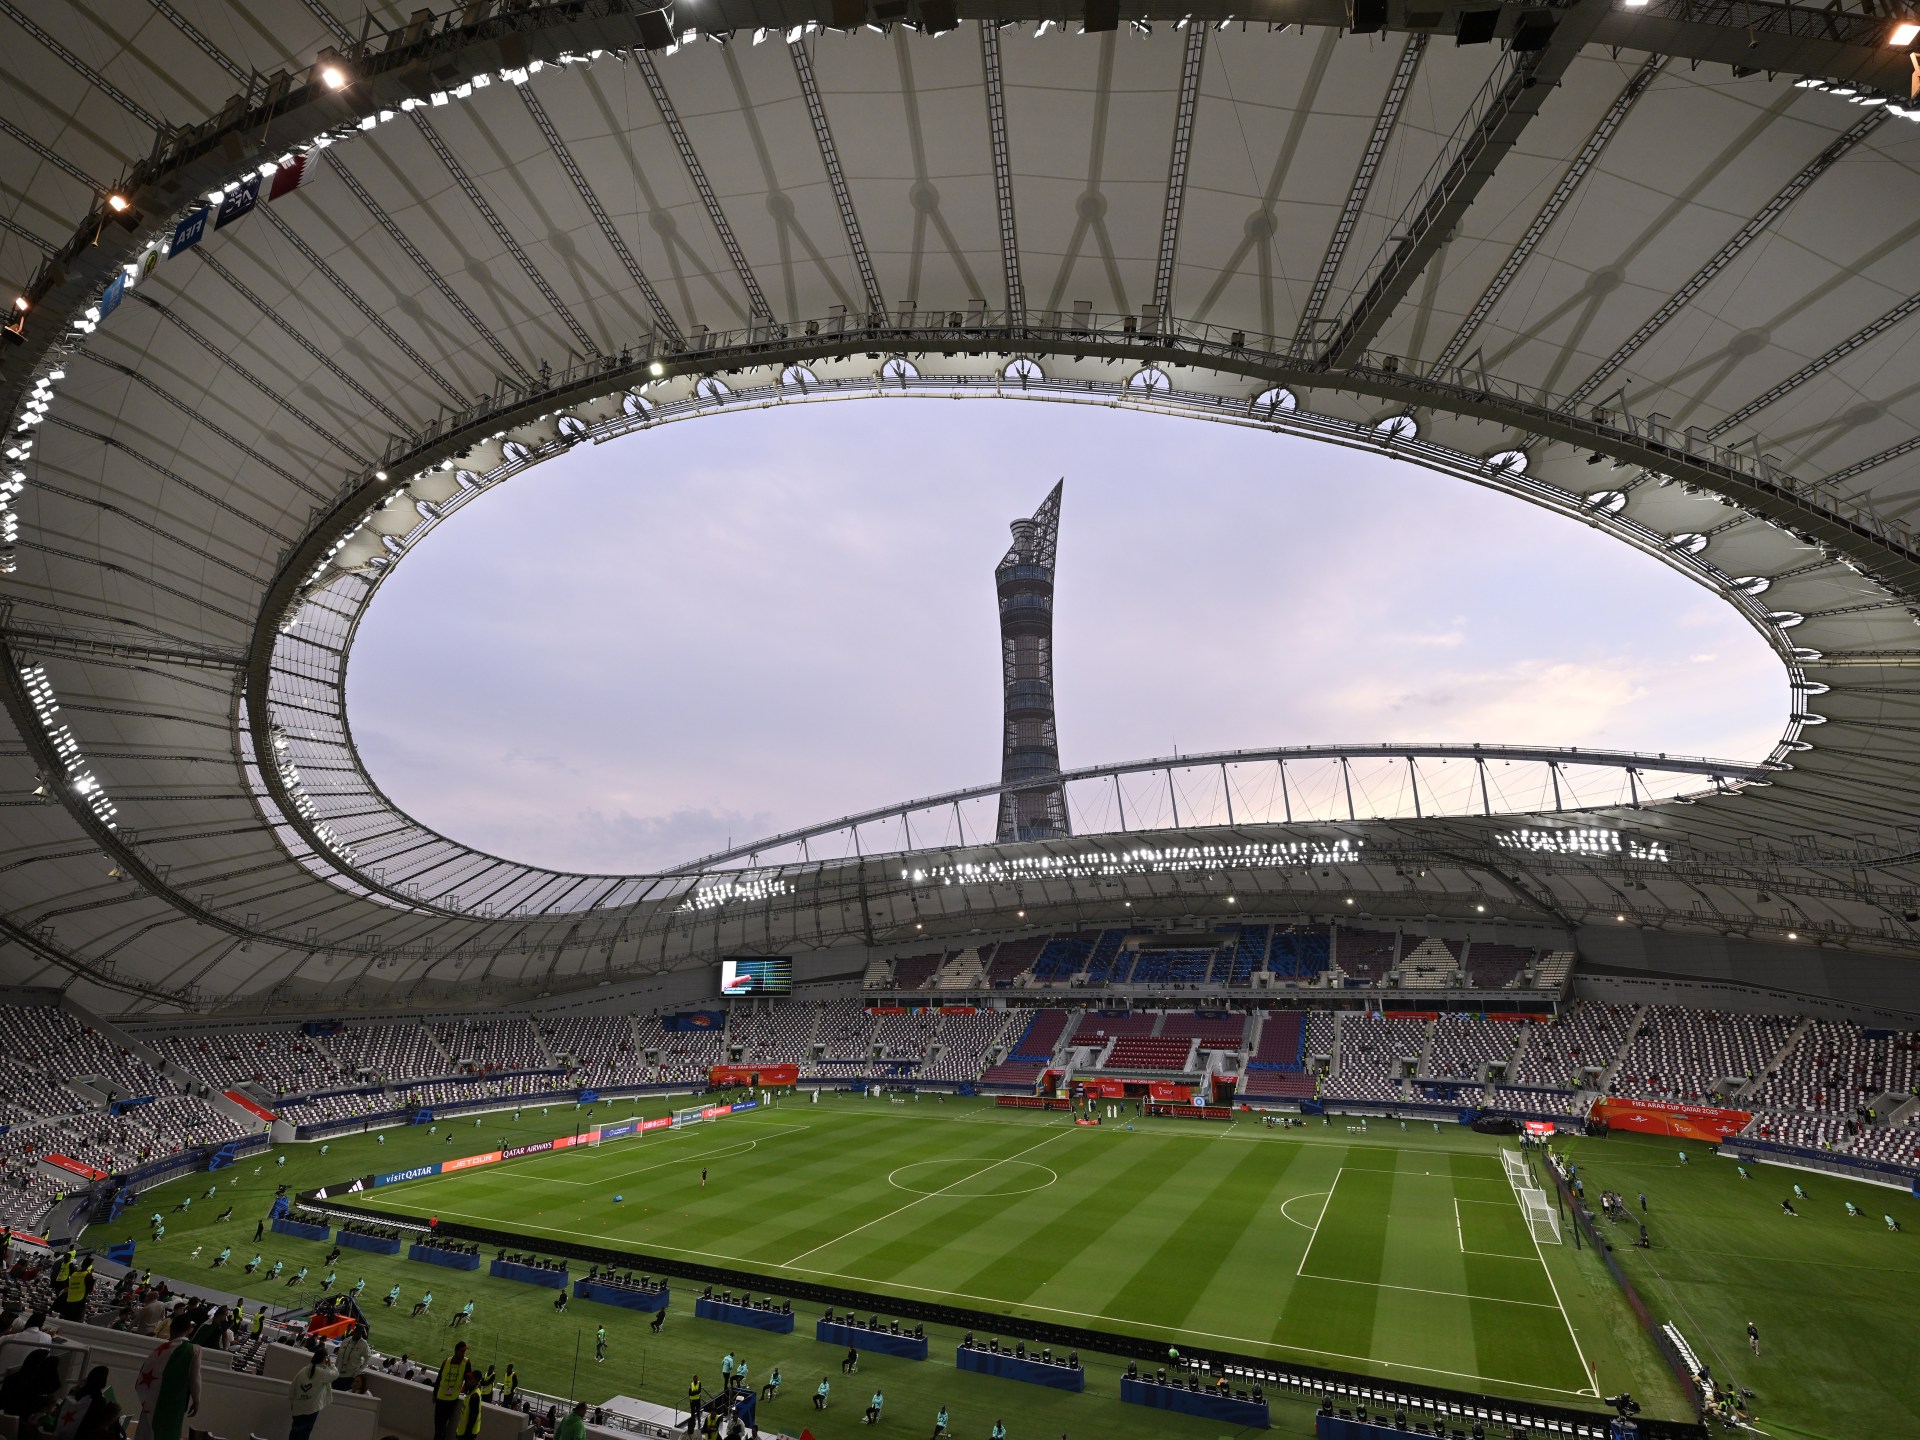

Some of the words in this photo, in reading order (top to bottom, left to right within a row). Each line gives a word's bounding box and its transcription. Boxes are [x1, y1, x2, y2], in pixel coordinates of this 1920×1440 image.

[1681, 1105, 1702, 1113] QATAR
[1702, 1108, 1719, 1116] 2025
[502, 1147, 525, 1159] QATAR
[526, 1141, 553, 1153] AIRWAYS
[452, 1154, 493, 1169] JETOUR
